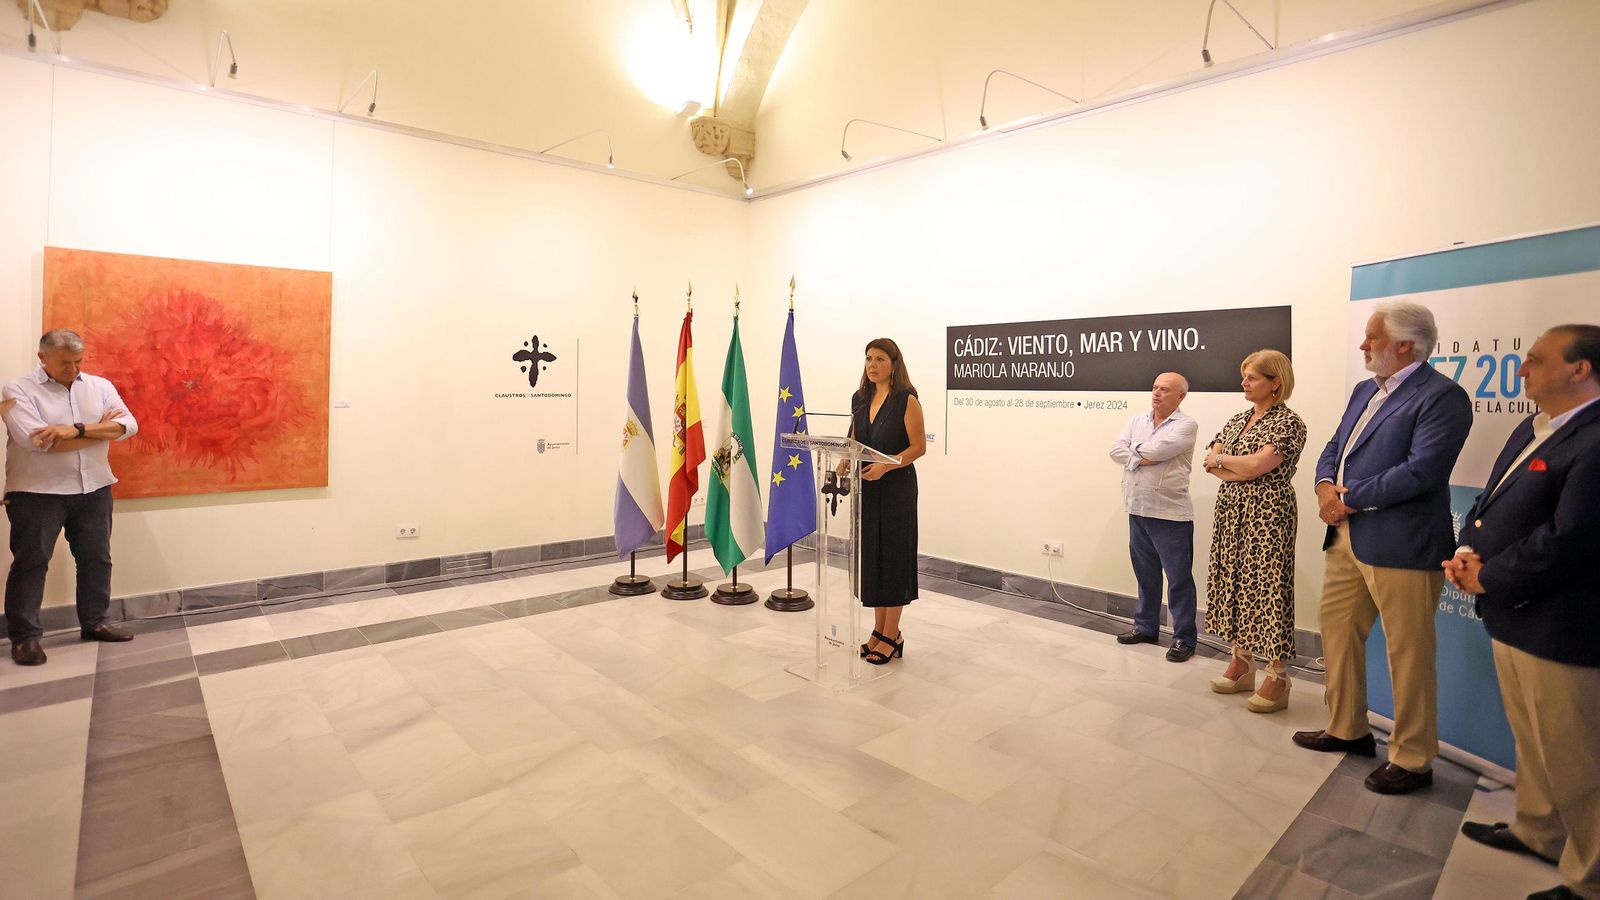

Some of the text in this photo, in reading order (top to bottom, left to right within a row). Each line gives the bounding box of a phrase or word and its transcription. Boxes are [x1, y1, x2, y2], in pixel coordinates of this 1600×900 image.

[954, 327, 1206, 358] CÁDIZ: VIENTO, MAR Y VINO.
[954, 361, 1075, 378] MARIOLA NARANJO
[953, 397, 1128, 410] Del 30 de agosto al 28 de septiembre Jerez 2024
[1487, 401, 1502, 413] LA
[1440, 601, 1454, 613] de
